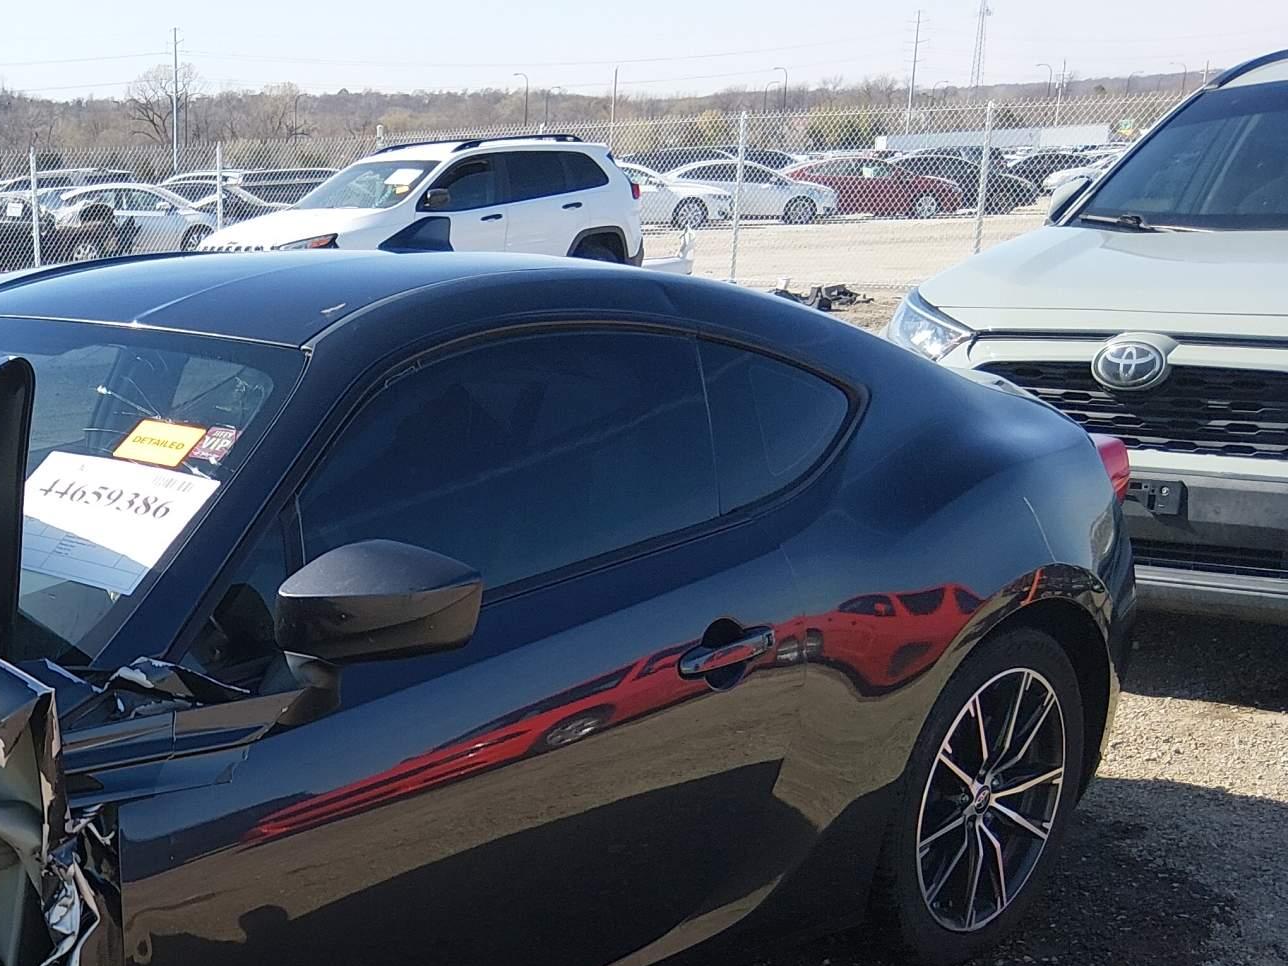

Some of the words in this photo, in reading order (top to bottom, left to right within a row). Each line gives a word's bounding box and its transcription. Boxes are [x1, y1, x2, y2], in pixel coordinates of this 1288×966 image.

[132, 435, 185, 450] DETAILED
[202, 436, 232, 450] VIP
[39, 478, 174, 519] 44659386
